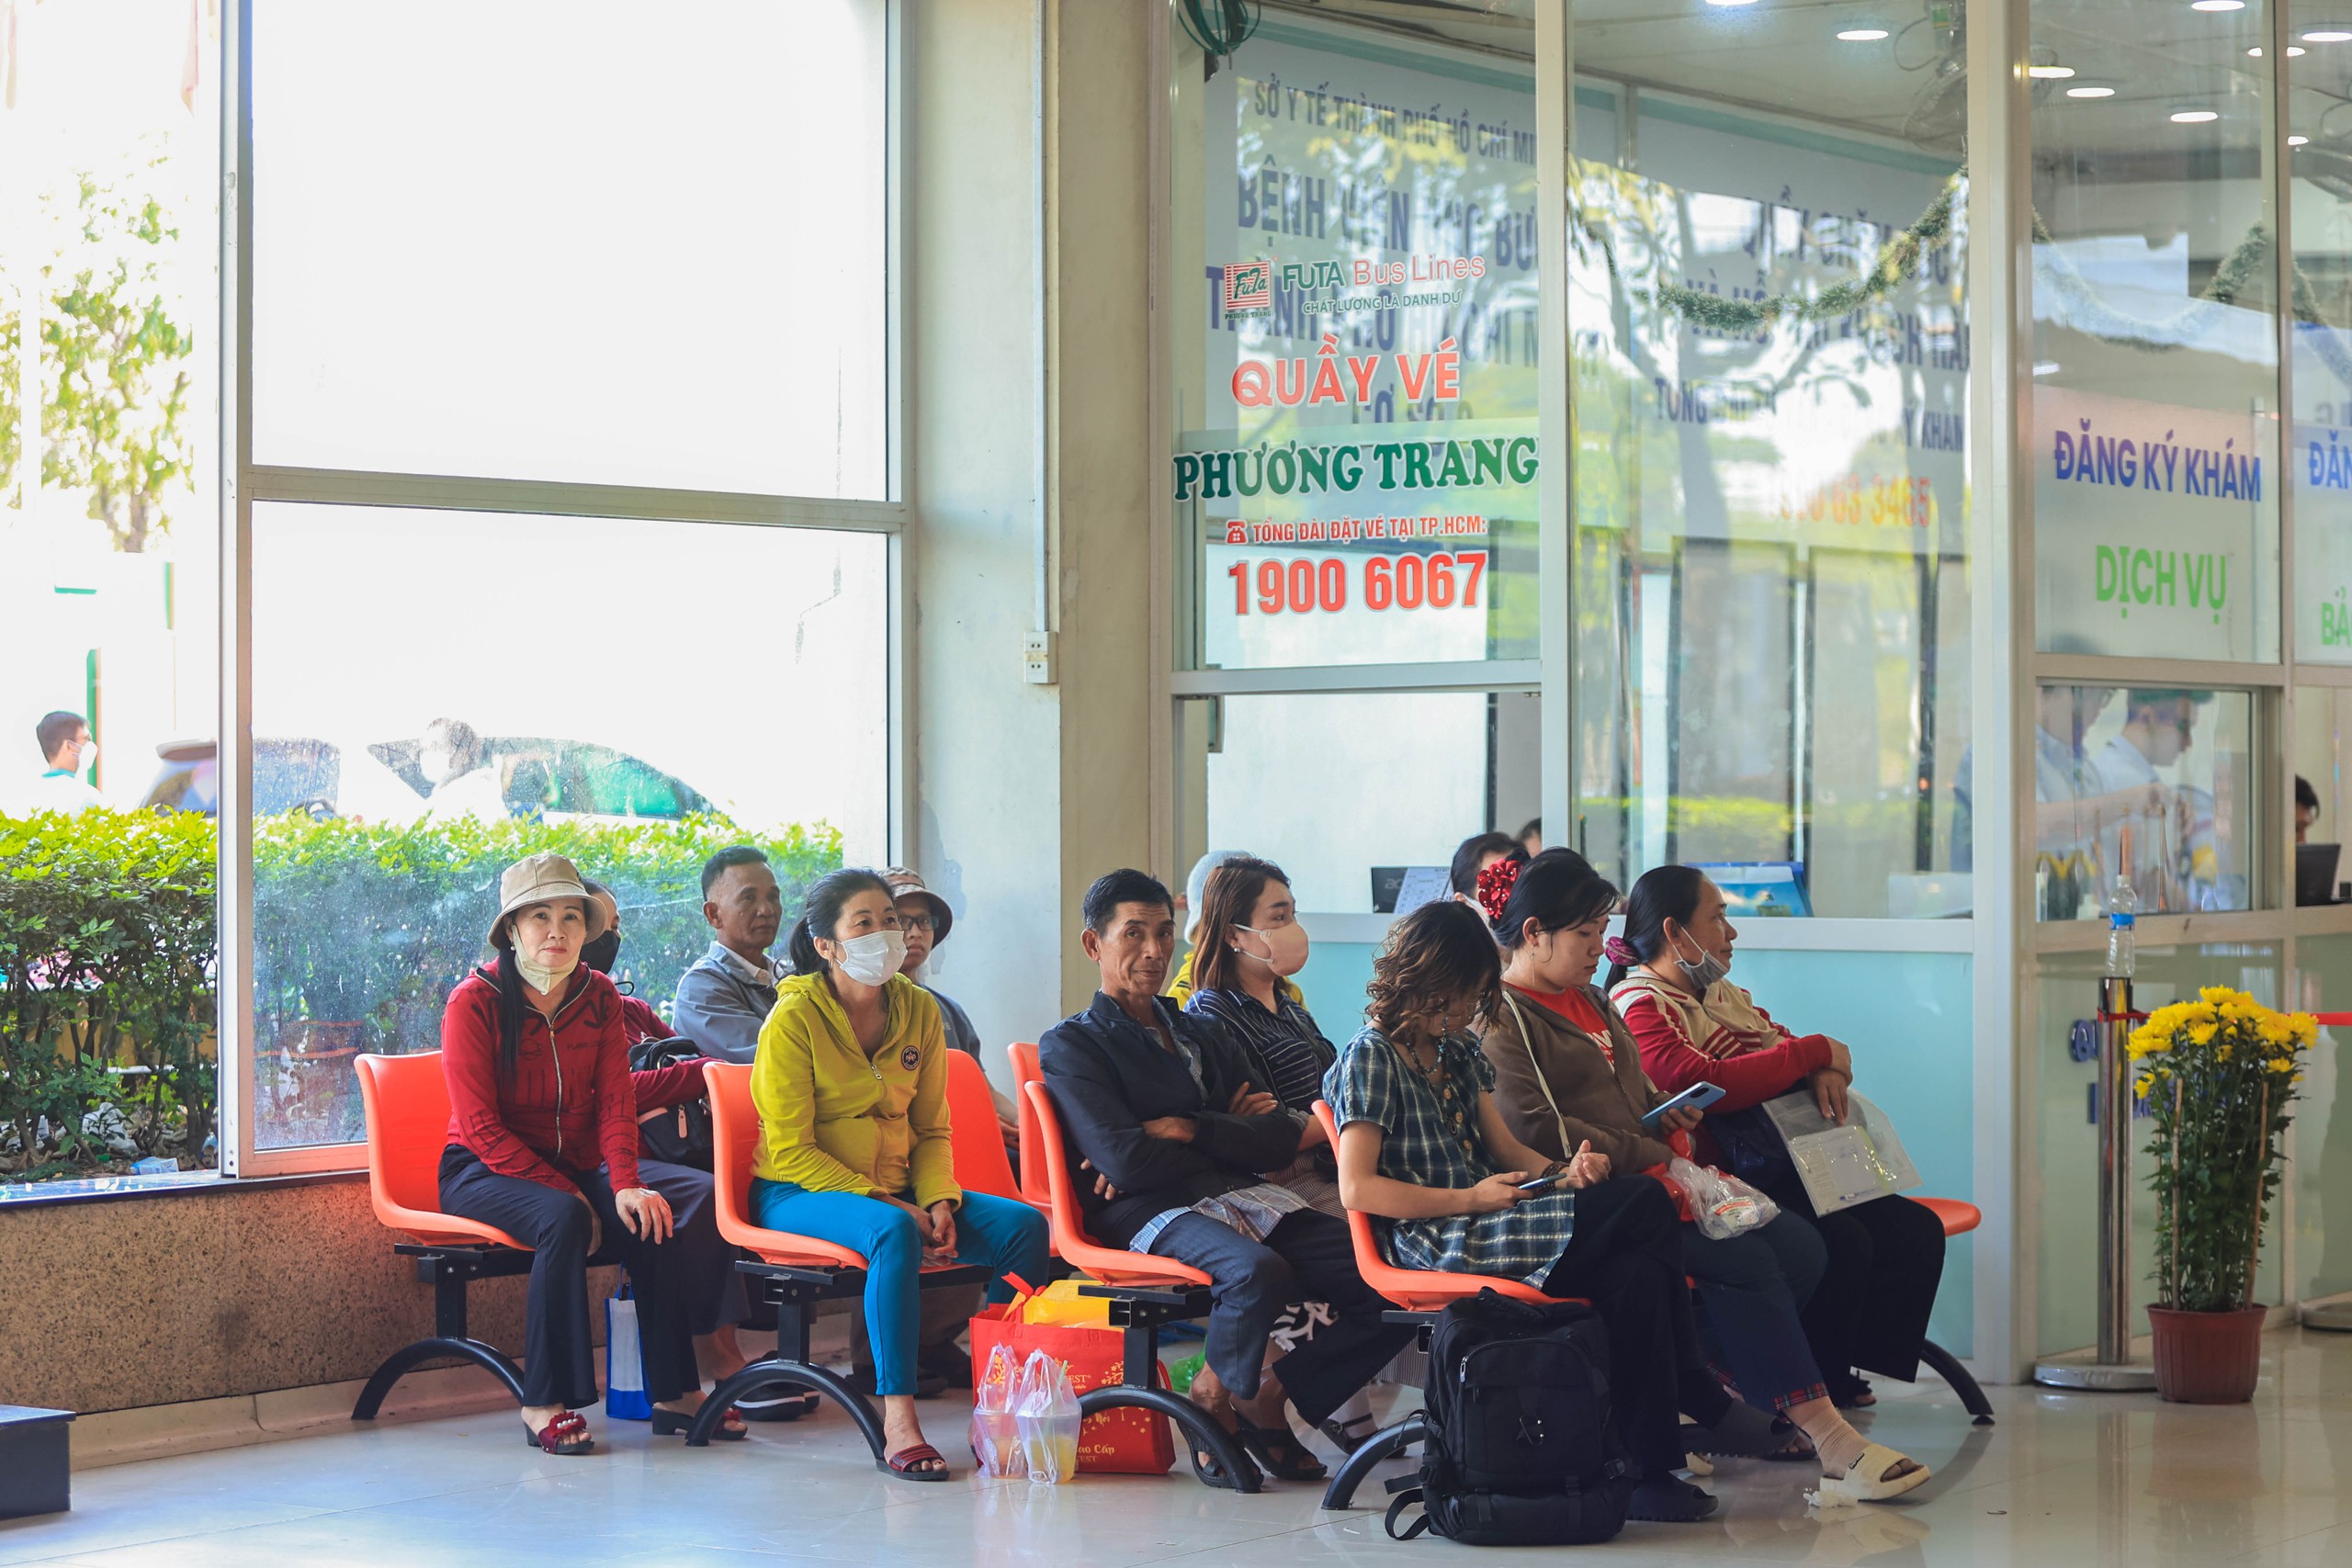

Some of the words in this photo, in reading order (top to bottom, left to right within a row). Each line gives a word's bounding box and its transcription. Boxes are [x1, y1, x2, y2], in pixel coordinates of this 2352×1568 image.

[1255, 73, 1280, 118] SỞ
[1286, 87, 1300, 121] Y
[1304, 82, 1329, 126] TẾ
[1333, 92, 1396, 140] THÀNH
[1403, 104, 1441, 147] PHỐ
[1238, 153, 1326, 248] BỆNH
[1283, 261, 1346, 292] FUTA
[1354, 259, 1407, 286] Bus
[1412, 254, 1487, 281] Lines
[1304, 298, 1335, 314] CHẤT
[1338, 297, 1383, 315] LƯỢNG
[1385, 293, 1399, 309] LÀ
[1403, 292, 1439, 307] DANH
[1442, 288, 1464, 308] DỰ
[1232, 332, 1381, 408] QUẦY
[1396, 334, 1460, 401] VÉ
[1174, 440, 1363, 502] PHƯƠNG
[1373, 435, 1539, 491] TRANG
[2054, 417, 2137, 488] ĐĂNG
[2143, 428, 2179, 492] KÝ
[2185, 436, 2262, 502] KHÁM
[1253, 517, 1295, 543] TỔNG
[1299, 519, 1327, 540] ĐÀI
[1330, 516, 1362, 545] ĐẶT
[1365, 513, 1385, 539] VÉ
[1389, 517, 1416, 542] TẠI
[1419, 514, 1488, 536] TP.HCM:
[1227, 558, 1348, 616] 1900
[1363, 550, 1489, 613] 6067
[2096, 544, 2177, 619] DỊCH
[2183, 552, 2227, 626] VỤ
[1078, 1445, 1091, 1454] ao
